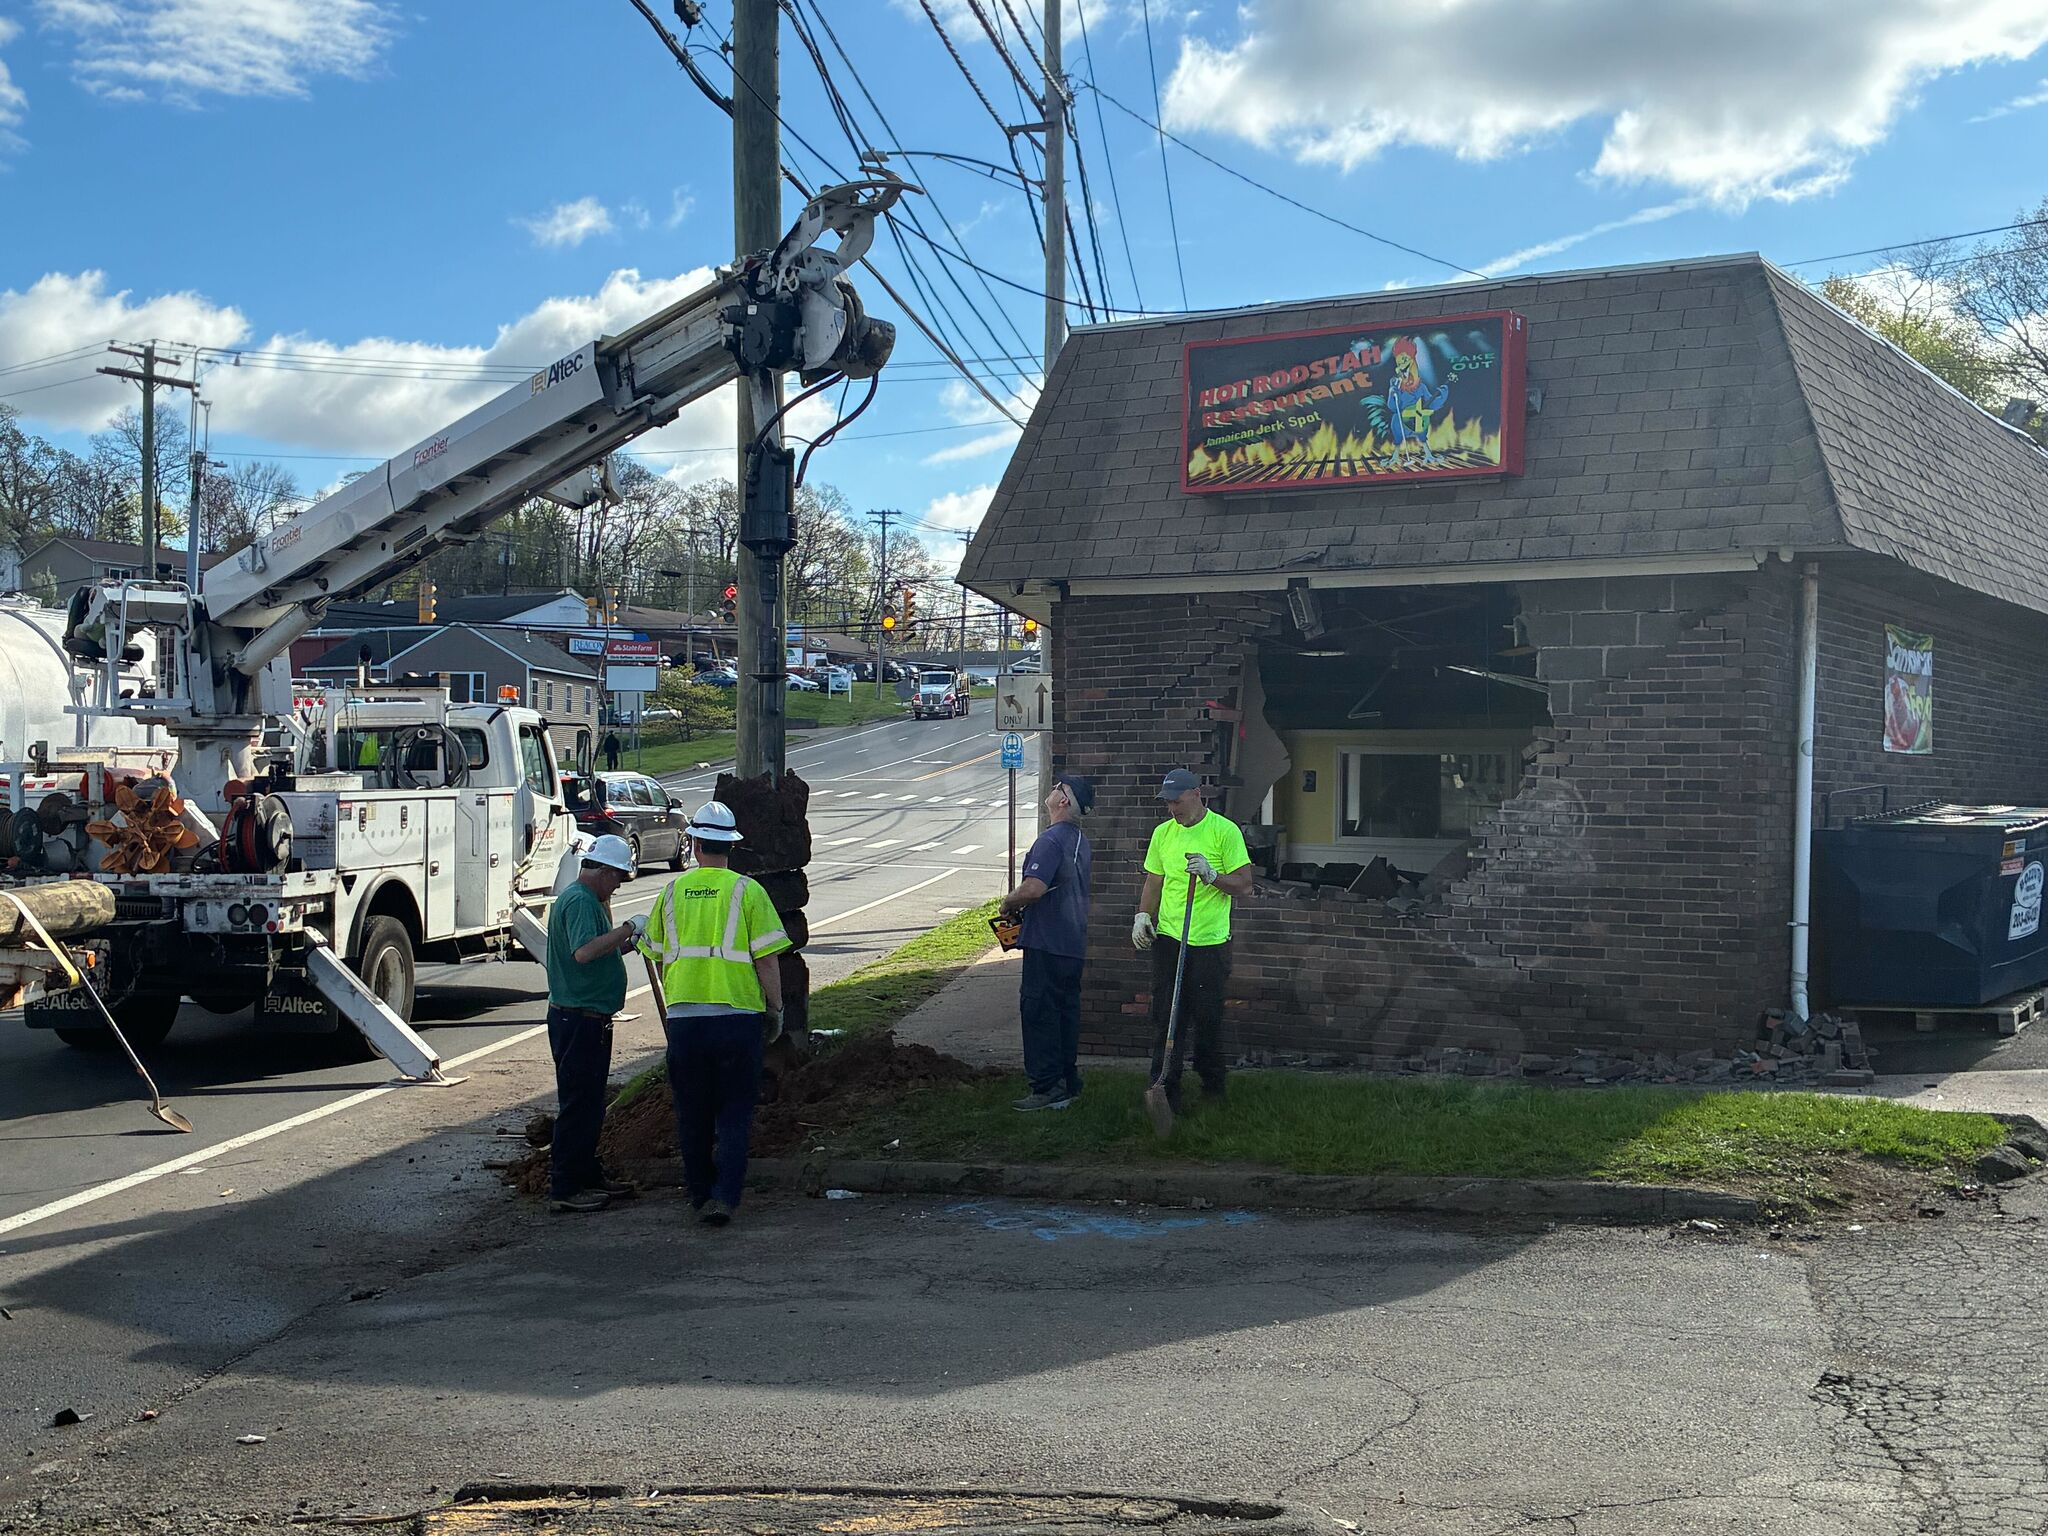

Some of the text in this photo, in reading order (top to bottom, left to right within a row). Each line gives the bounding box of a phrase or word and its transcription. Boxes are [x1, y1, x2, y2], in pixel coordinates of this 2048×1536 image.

[1450, 352, 1496, 363] TAKE
[1452, 361, 1493, 371] OUT
[547, 354, 583, 389] Altec
[1200, 345, 1382, 407] HOT ROOSTAH
[1202, 371, 1373, 427] Restaurant
[1204, 410, 1322, 447] Jamaican Jerk Spot
[414, 436, 449, 464] Frontier
[272, 525, 302, 551] Frontier
[1003, 715, 1023, 725] ONLY
[684, 888, 721, 897] Frontier
[281, 996, 324, 1014] Altec
